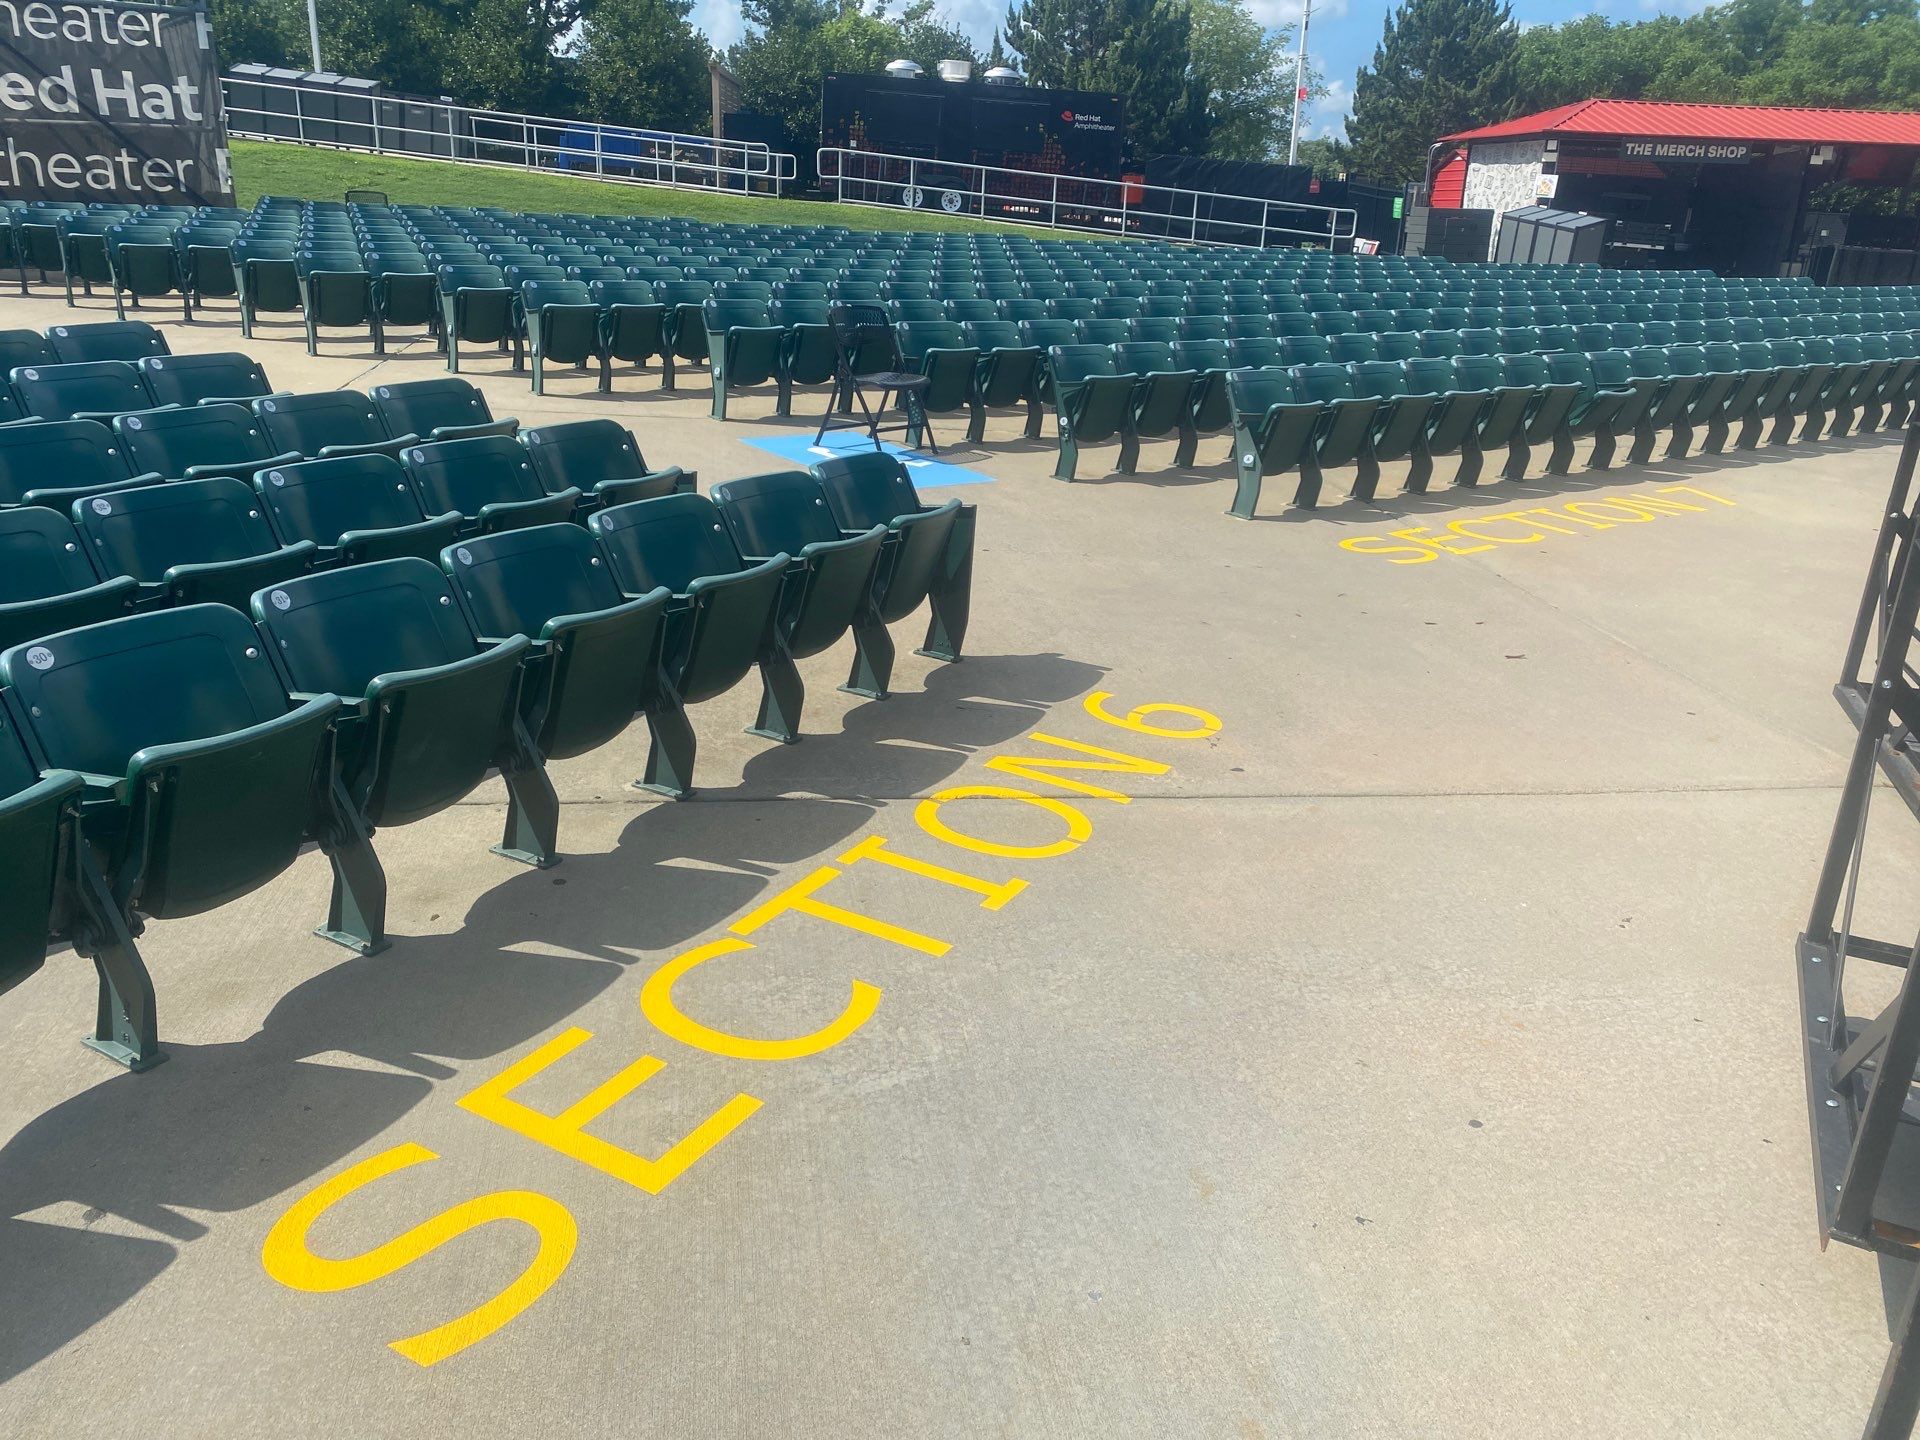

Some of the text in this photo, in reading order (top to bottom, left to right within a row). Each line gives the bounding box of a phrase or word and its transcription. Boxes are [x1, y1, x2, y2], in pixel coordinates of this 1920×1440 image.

[91, 68, 203, 121] Hat
[1074, 113, 1089, 121] Red
[1074, 122, 1115, 131] Amphitheater
[1626, 143, 1747, 158] THE MERCH SHOP
[1338, 485, 1738, 565] SECTION 7
[32, 652, 48, 665] 30
[262, 691, 1224, 1368] SECTION 6
